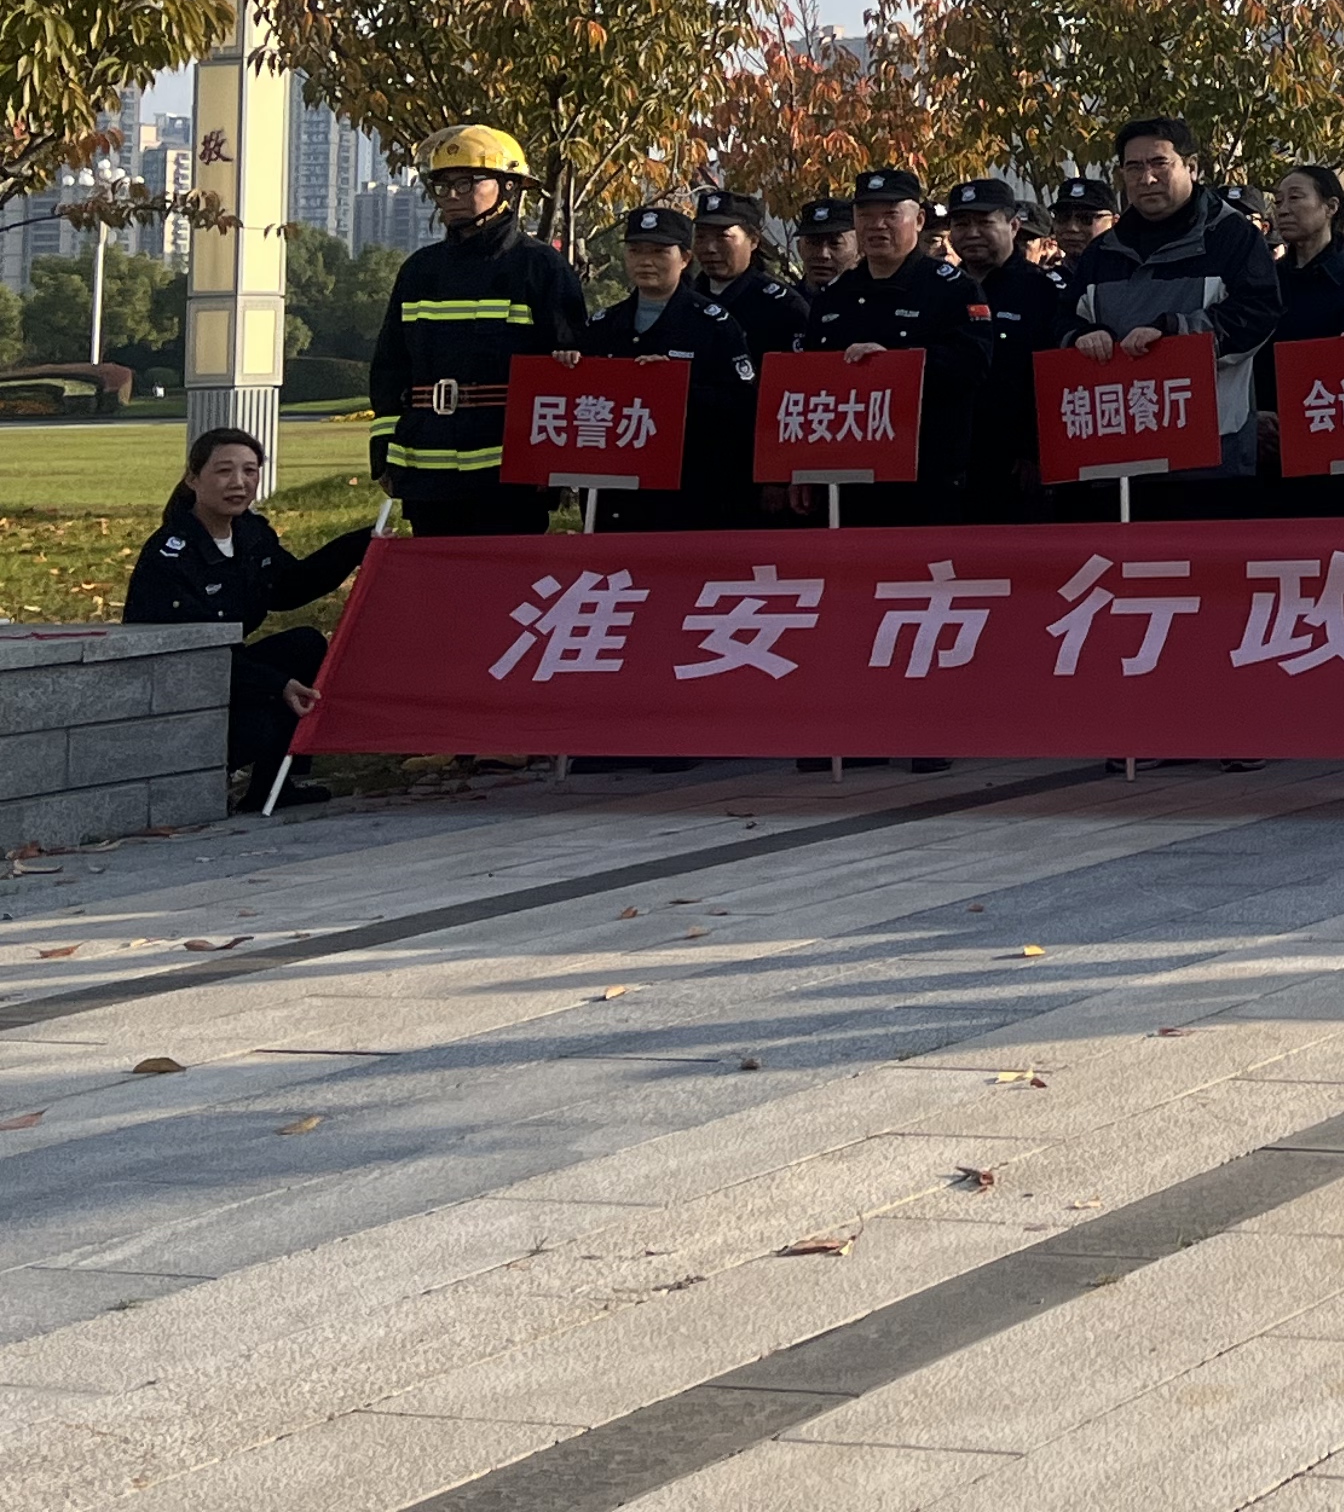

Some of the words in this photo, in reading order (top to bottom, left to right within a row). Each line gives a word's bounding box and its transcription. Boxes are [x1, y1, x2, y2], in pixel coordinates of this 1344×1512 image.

[531, 396, 656, 448] 民警办
[778, 389, 895, 442] 保安大队
[1061, 378, 1192, 439] 锦园餐厅
